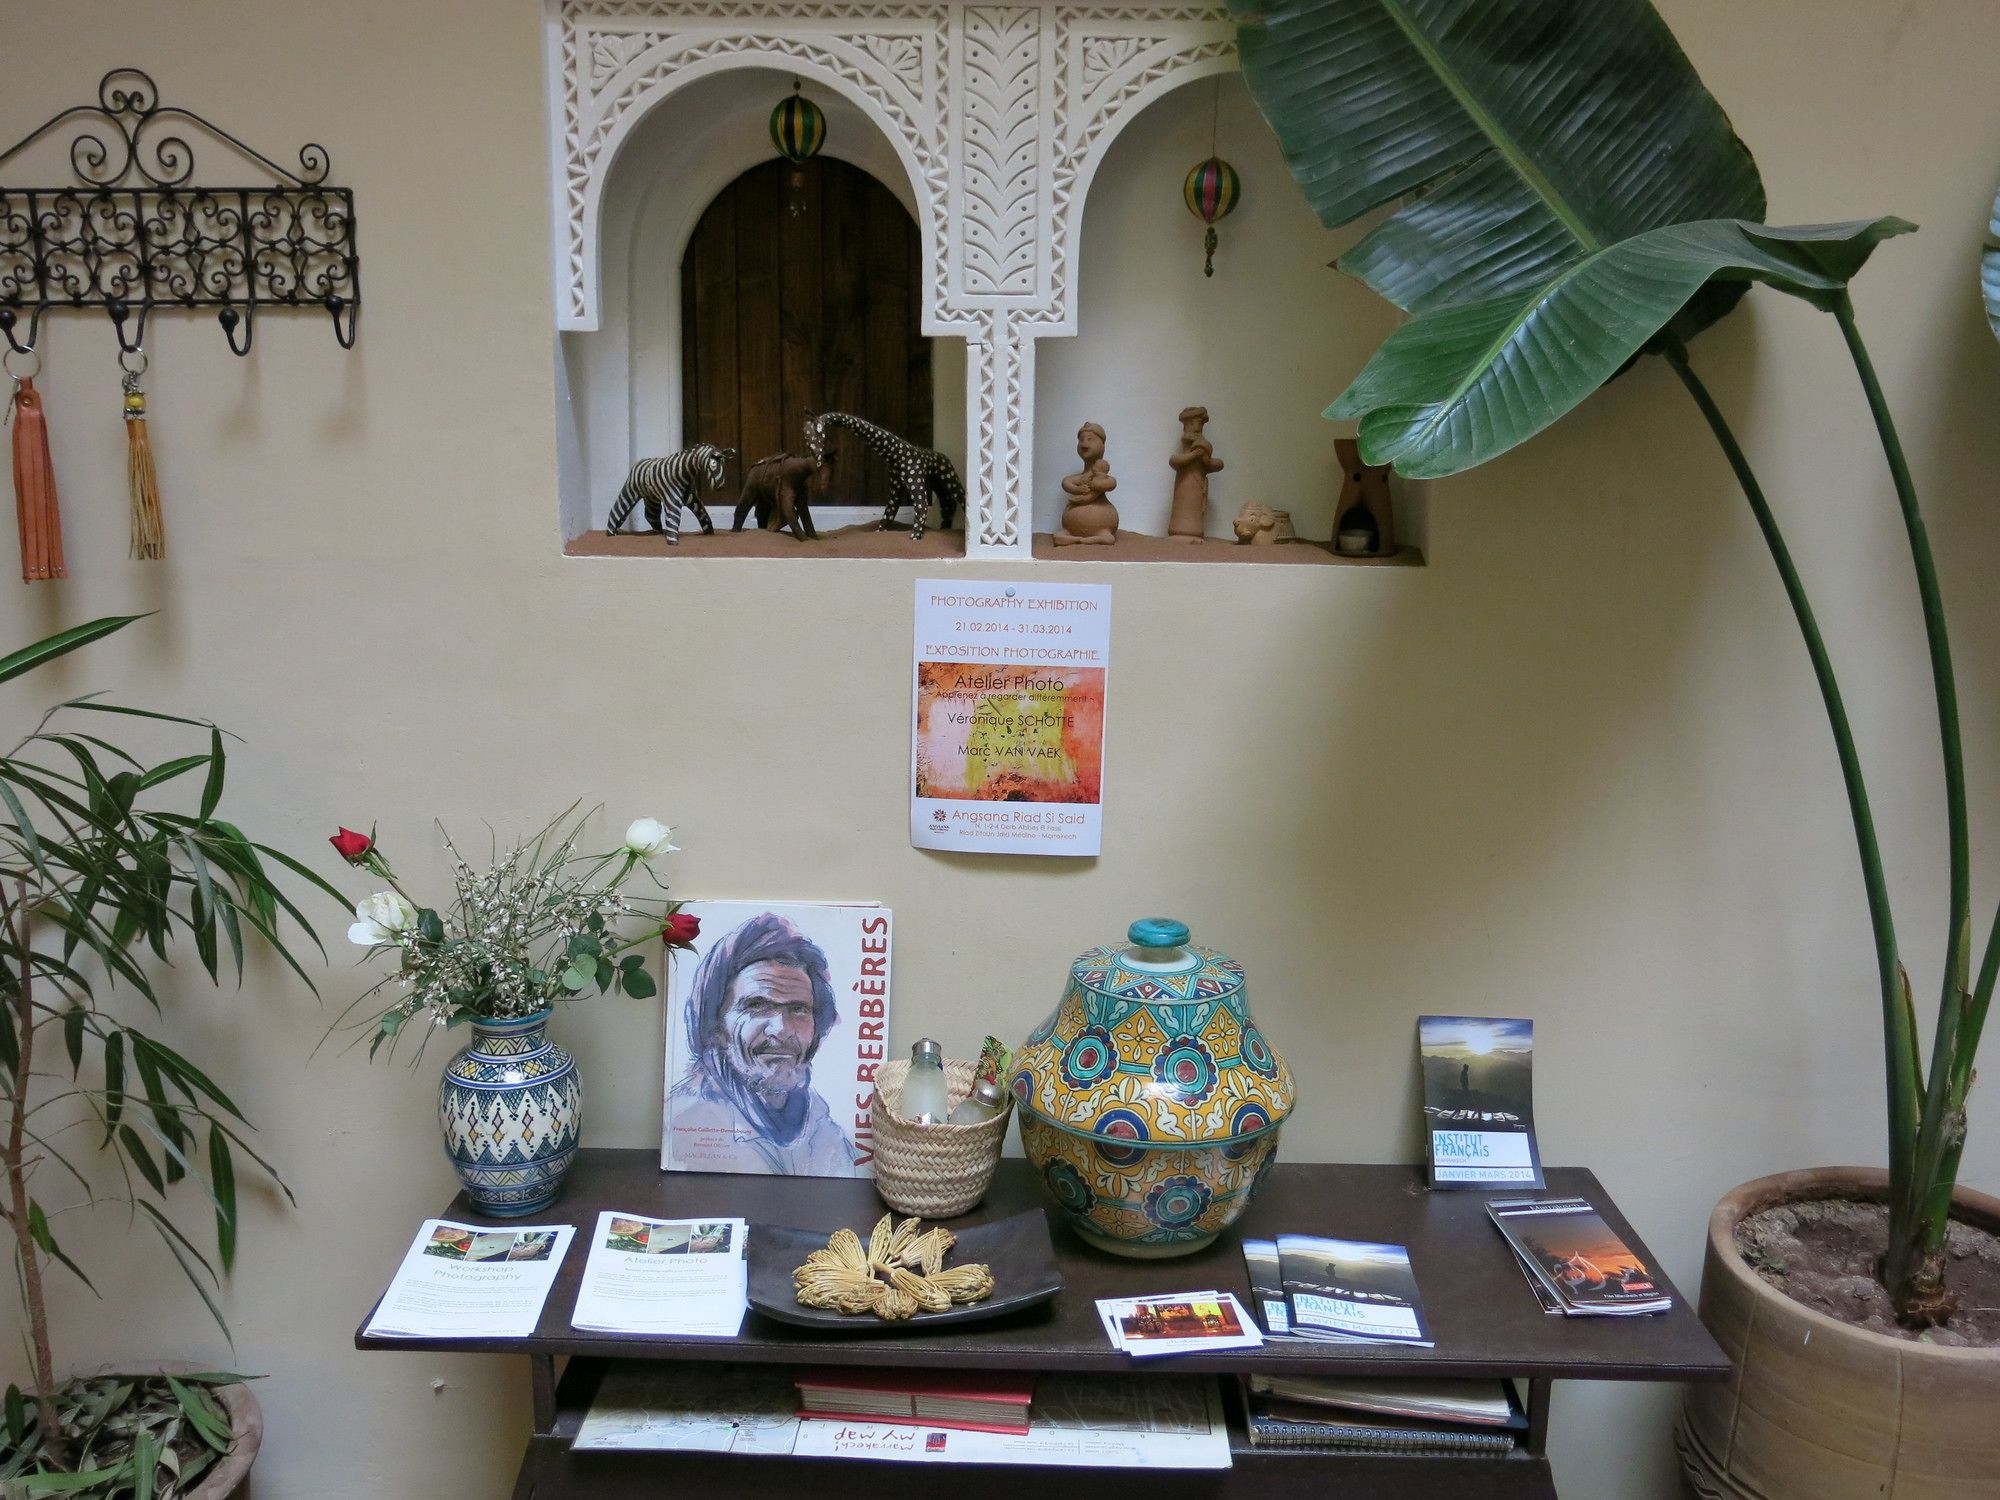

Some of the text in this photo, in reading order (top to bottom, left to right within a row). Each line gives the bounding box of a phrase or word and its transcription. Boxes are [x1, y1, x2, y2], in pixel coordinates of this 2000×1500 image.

[931, 595, 1098, 611] PHOTOGRAPHY EXHIBITION
[955, 621, 1009, 632] 21.02.2014
[1018, 623, 1073, 634] 31.03.2014
[926, 645, 1100, 660] EXPOSITION PHOTOGRAPHIE
[954, 674, 1064, 692] Atelier Photo
[936, 690, 978, 700] Apprenez
[988, 693, 1027, 702] regarder
[947, 712, 1075, 729] Véronique SCHOTTE
[958, 745, 1061, 759] Marc VAN VAEK
[951, 809, 1085, 826] Angsana Riad Si Said
[852, 917, 888, 1167] VIES BERBÈRES
[1434, 1133, 1483, 1146] INSTITUT
[1436, 1144, 1490, 1159] FRANÇAIS
[1437, 1169, 1531, 1179] JANVIER MARS 2014
[624, 1256, 708, 1265] Atelier Photo
[450, 1263, 514, 1273] Workshop
[434, 1269, 521, 1282] Photography
[1295, 1295, 1357, 1310] INSTITUT
